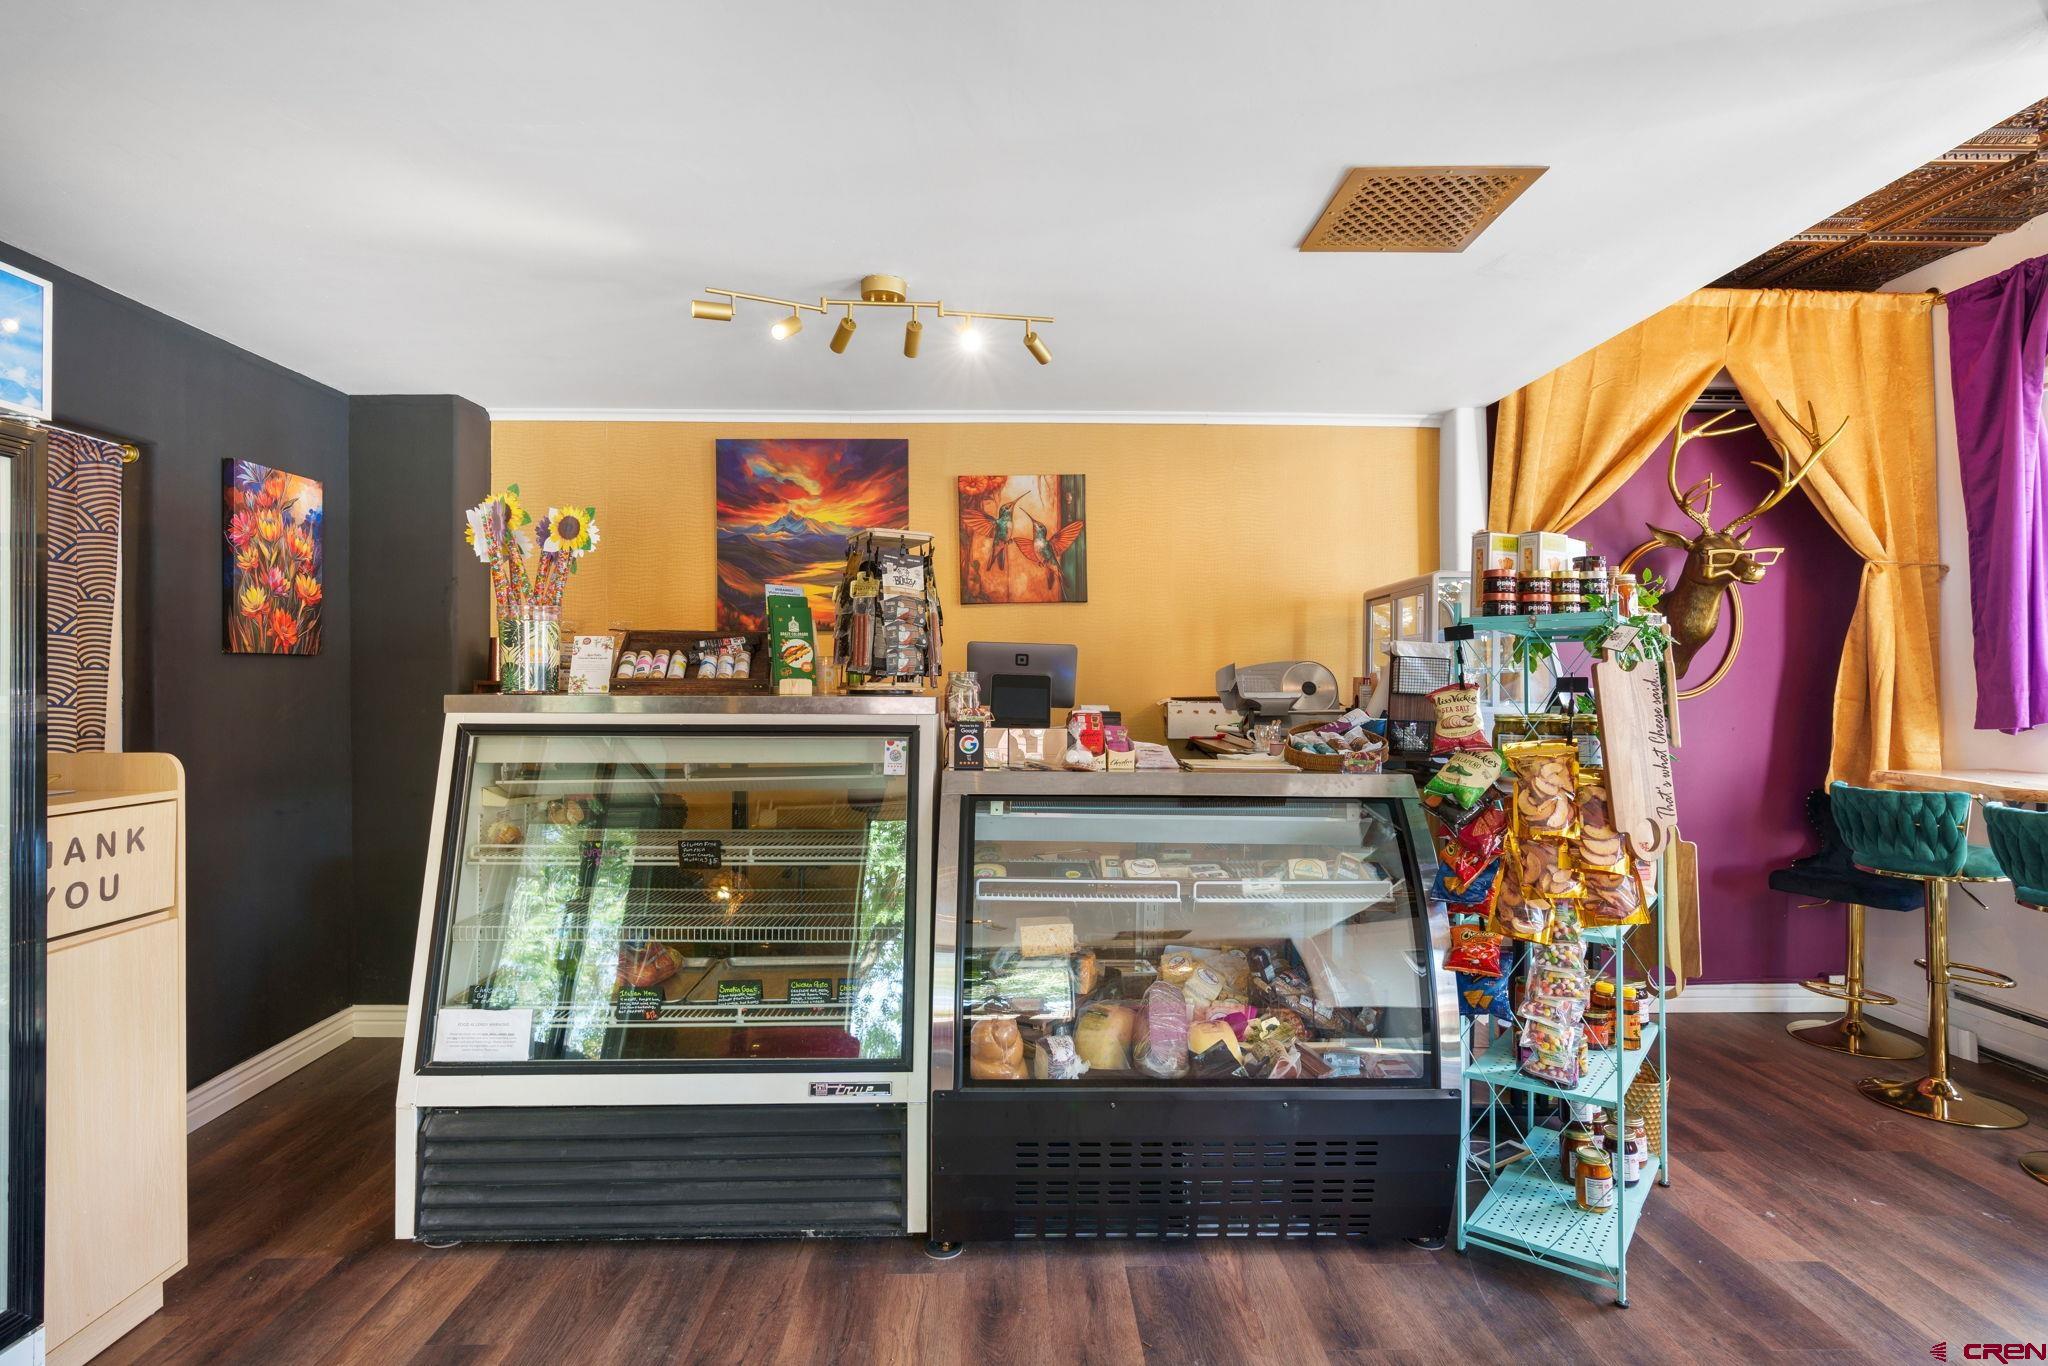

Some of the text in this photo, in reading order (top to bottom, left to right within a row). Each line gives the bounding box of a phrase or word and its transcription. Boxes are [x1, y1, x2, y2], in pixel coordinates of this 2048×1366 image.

[1441, 705, 1470, 714] SEA SALT
[1451, 693, 1477, 704] Vickie'
[1648, 708, 1667, 744] Cheese
[1652, 748, 1671, 779] what
[1656, 781, 1676, 820] That's
[47, 826, 145, 870] ANK
